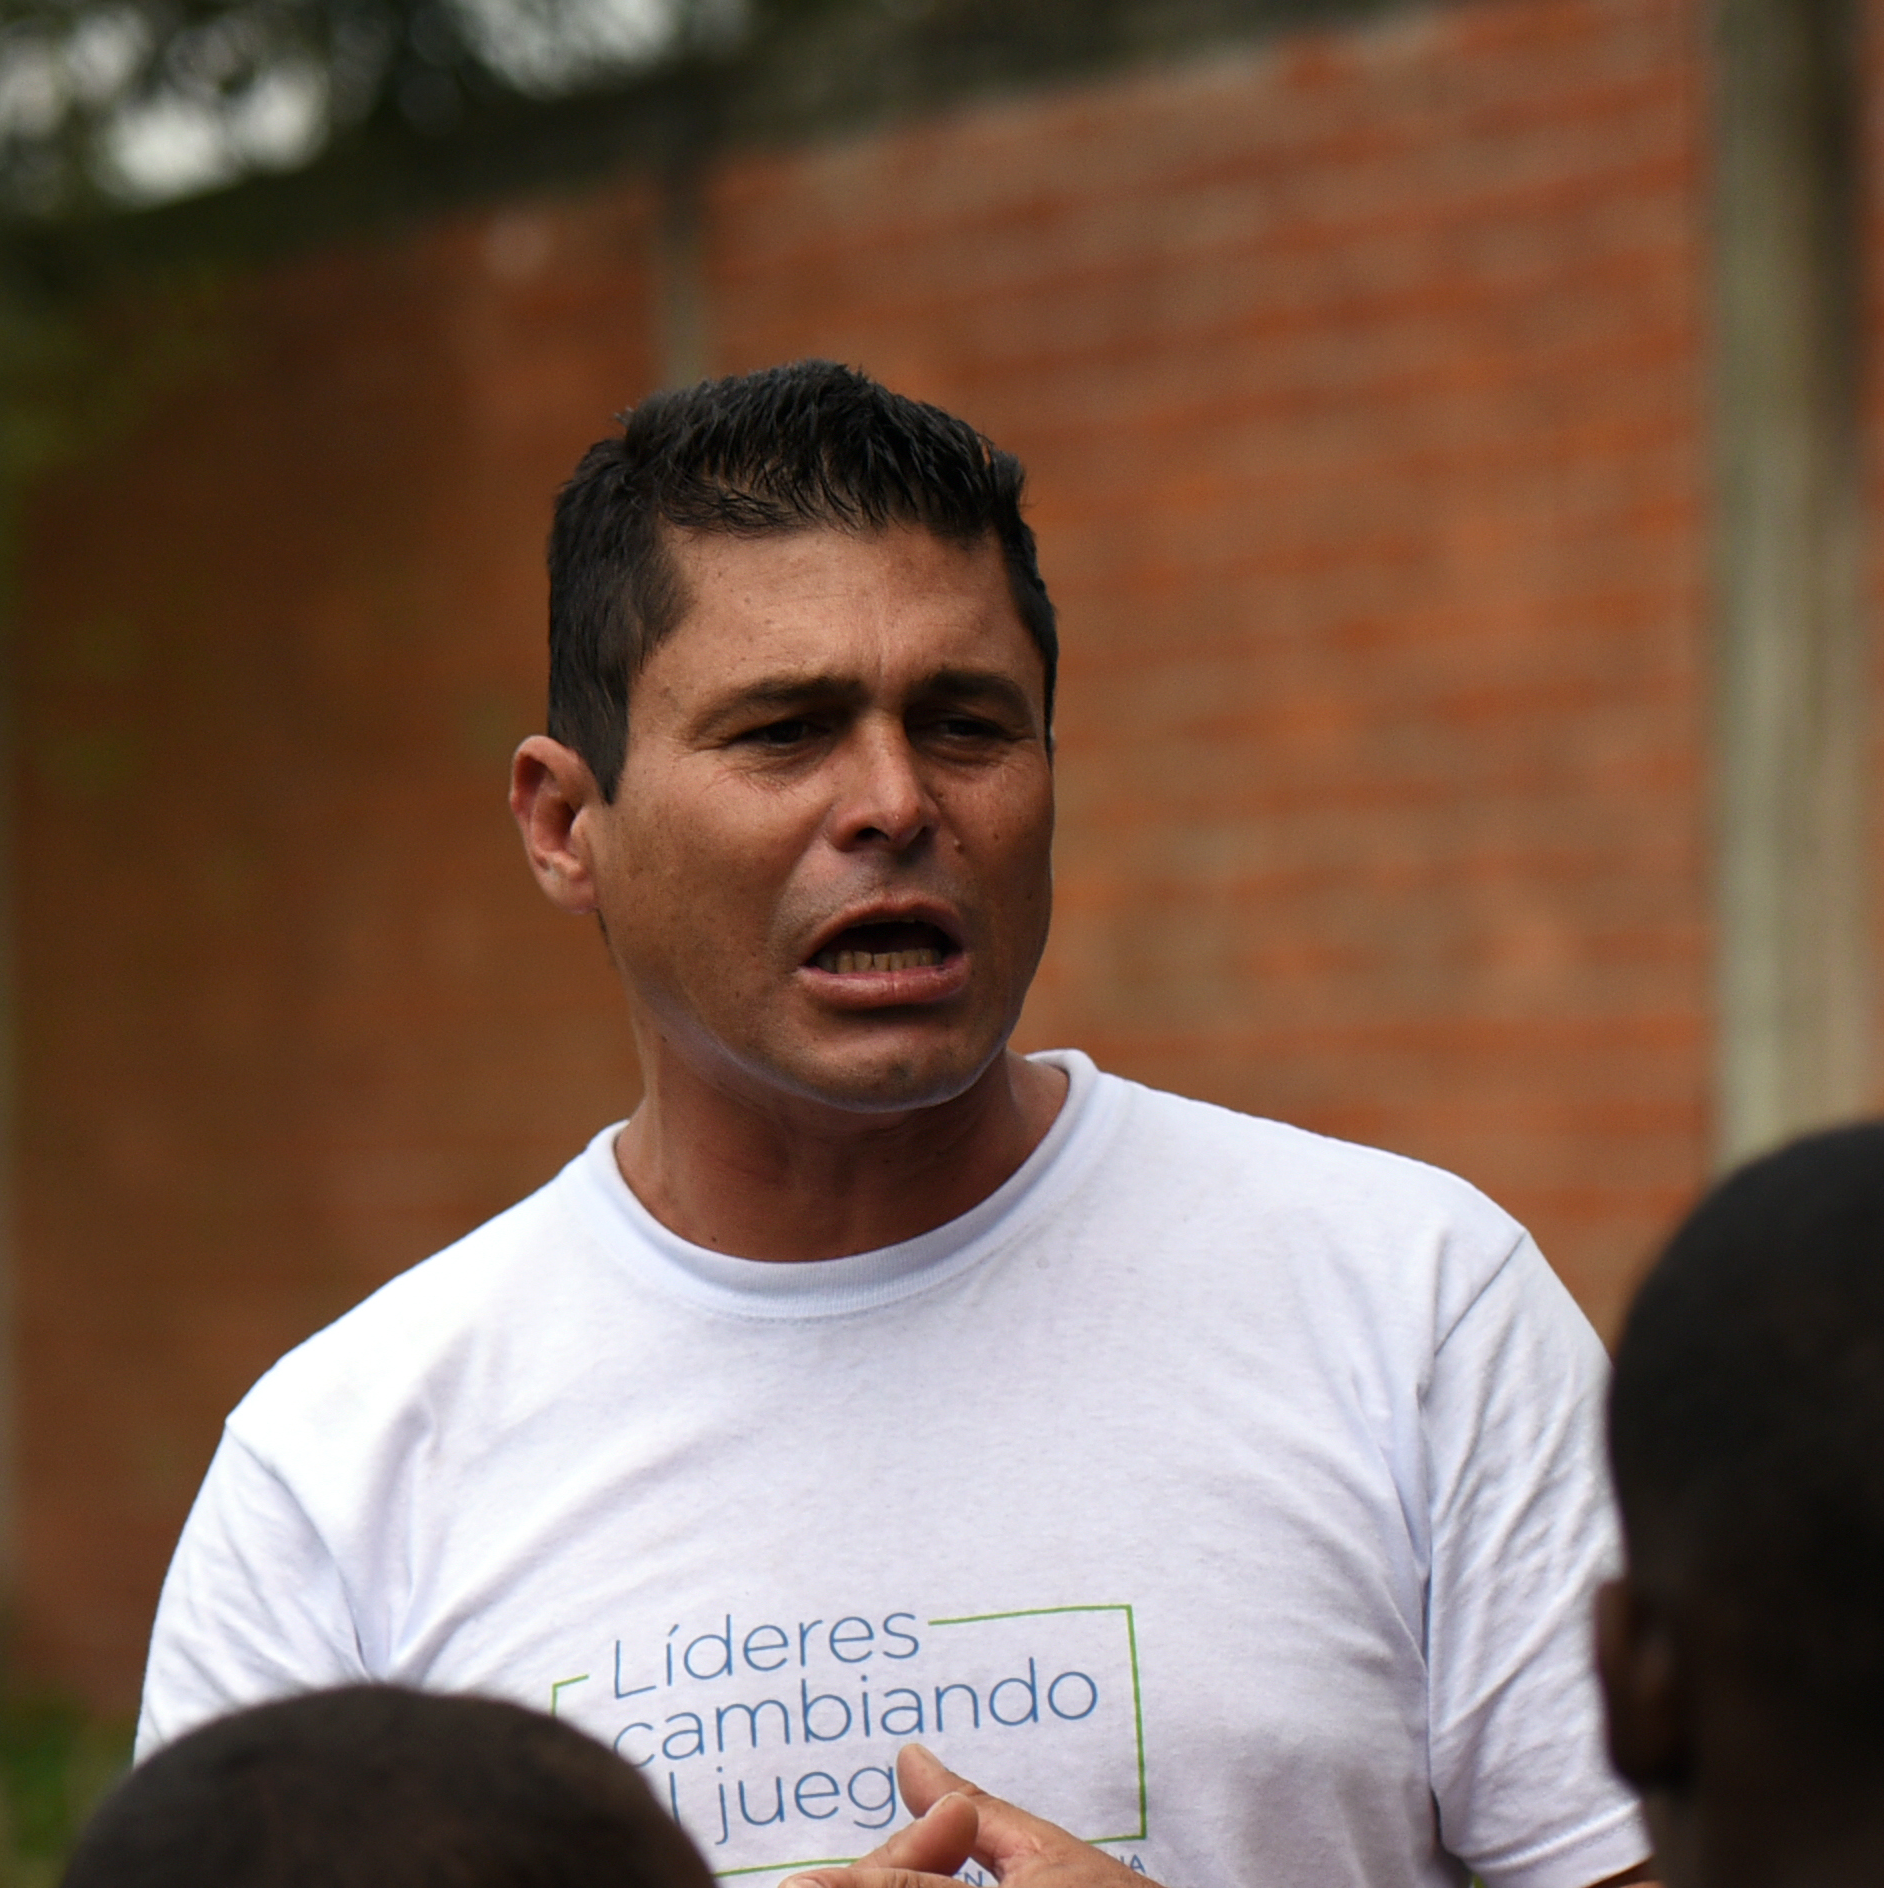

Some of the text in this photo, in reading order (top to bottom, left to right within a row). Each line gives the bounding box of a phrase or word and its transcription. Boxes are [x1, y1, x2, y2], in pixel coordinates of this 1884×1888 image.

[614, 1610, 920, 1700] Líderes
[614, 1657, 1099, 1768] cambiando
[714, 1765, 896, 1845] jueg
